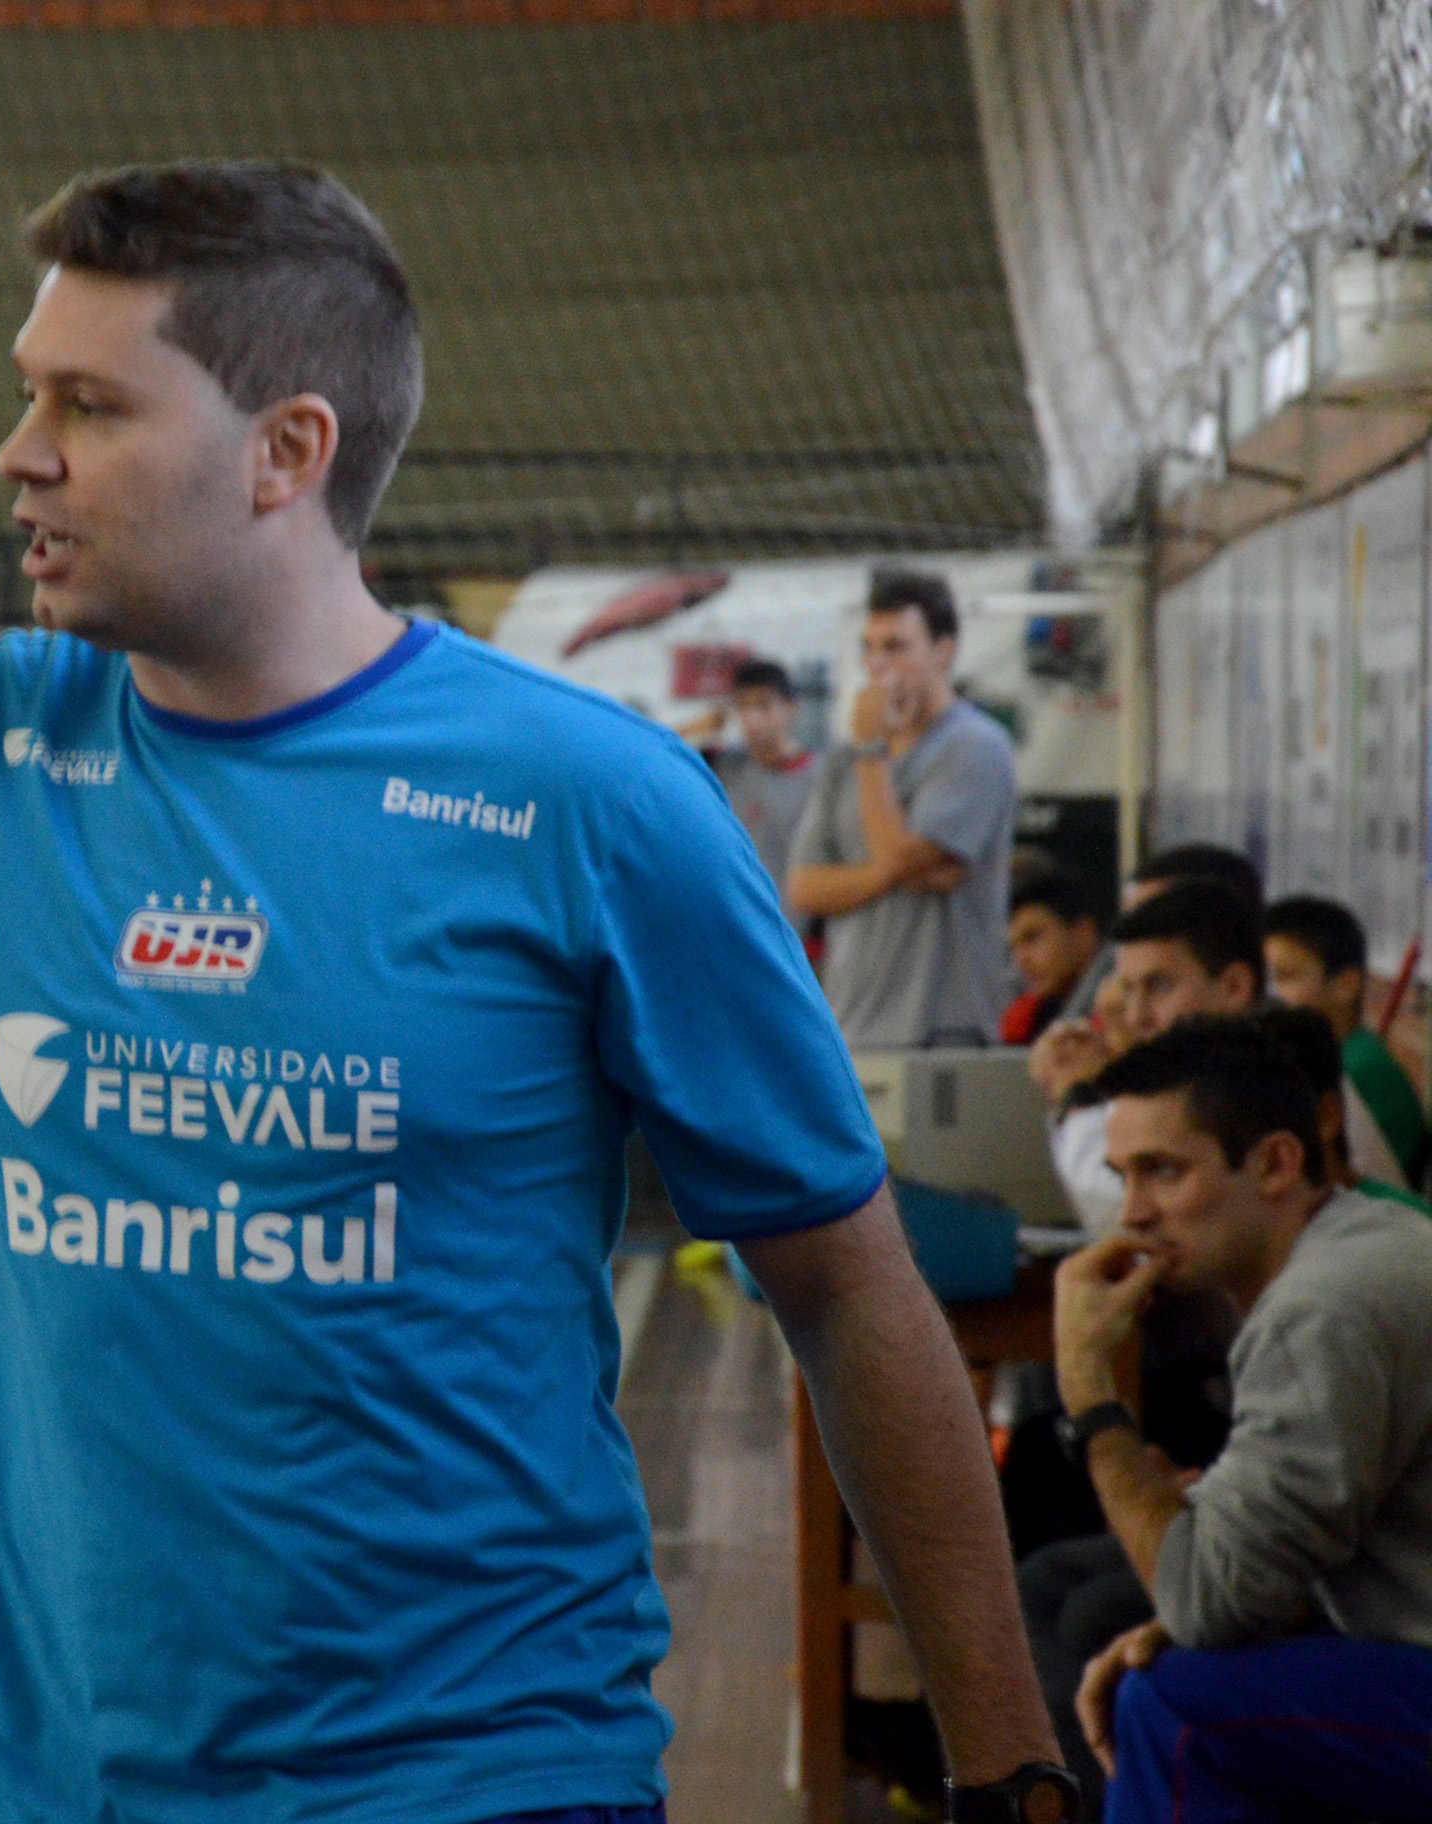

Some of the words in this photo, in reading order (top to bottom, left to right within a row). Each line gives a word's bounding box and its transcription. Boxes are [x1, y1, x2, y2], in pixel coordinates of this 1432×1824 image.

[382, 777, 537, 840] Banrisul
[84, 1030, 401, 1088] UNIVERSIDADE
[83, 1066, 401, 1153] FEEVALE
[1, 1157, 398, 1285] Banrisul
